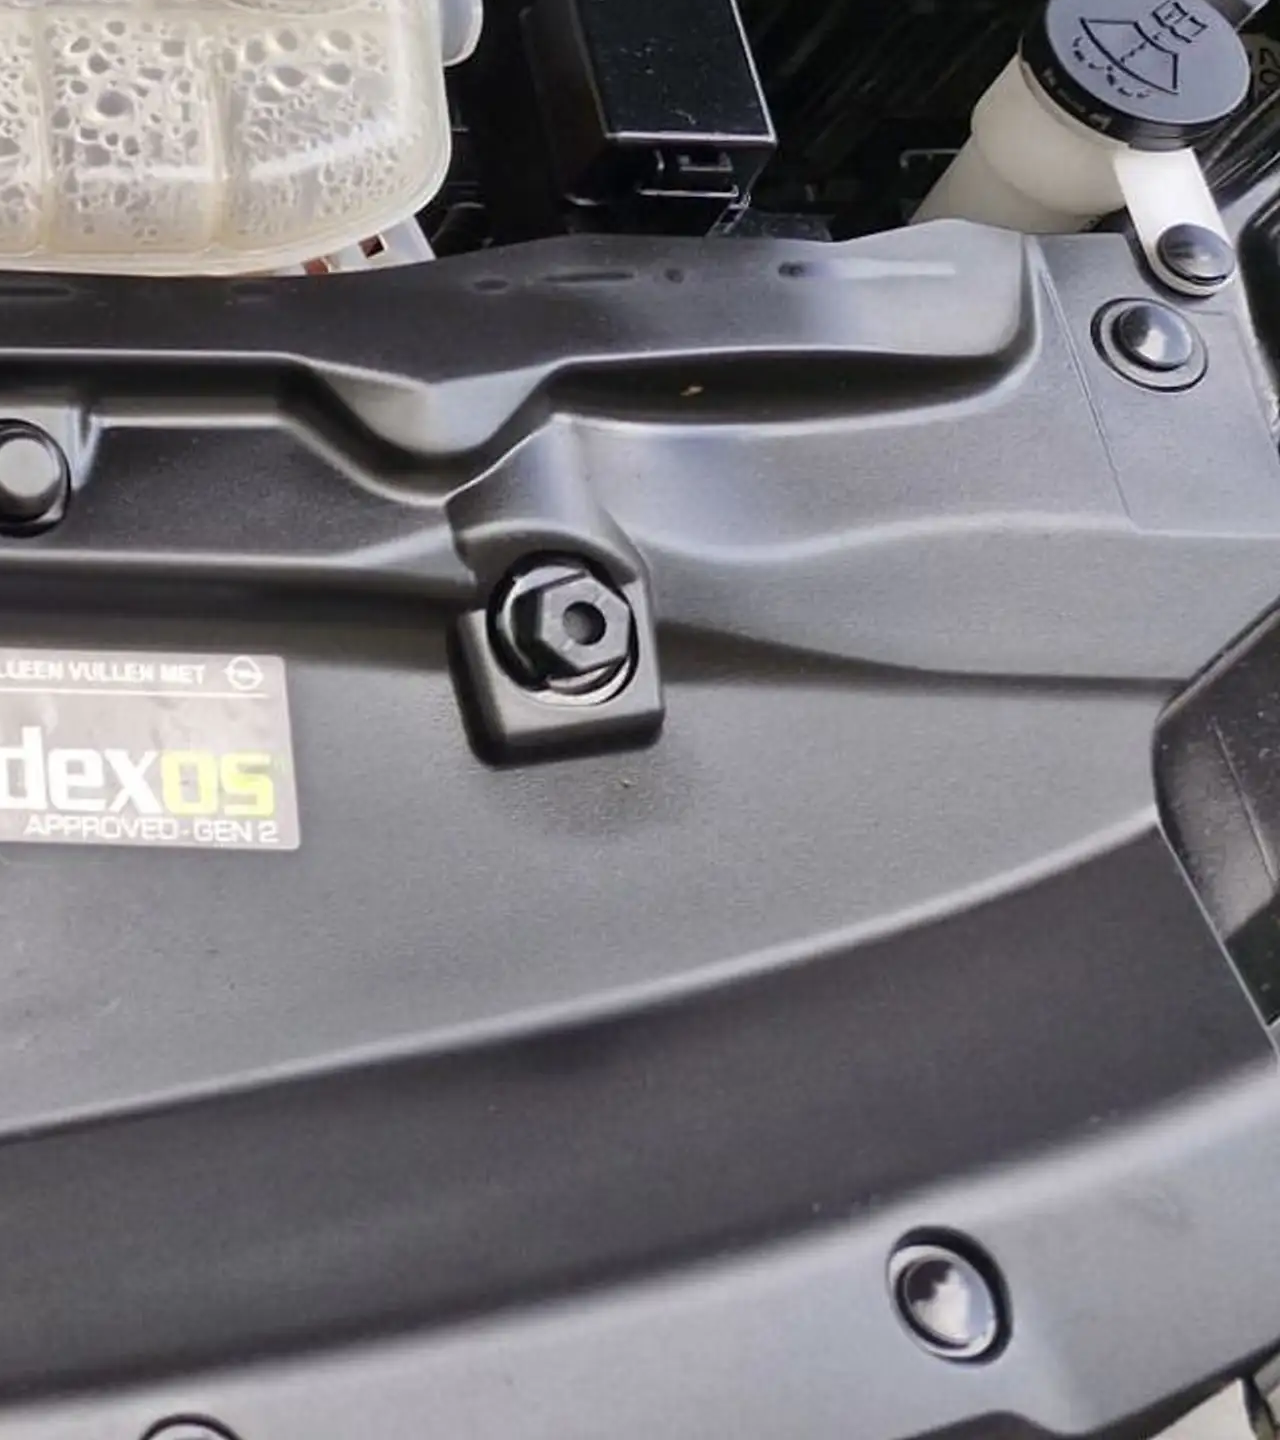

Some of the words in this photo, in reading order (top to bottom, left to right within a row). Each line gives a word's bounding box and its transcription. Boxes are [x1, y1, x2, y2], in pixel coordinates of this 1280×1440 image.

[68, 663, 155, 684] VULLEN
[160, 664, 205, 686] MET
[258, 821, 279, 843] 2
